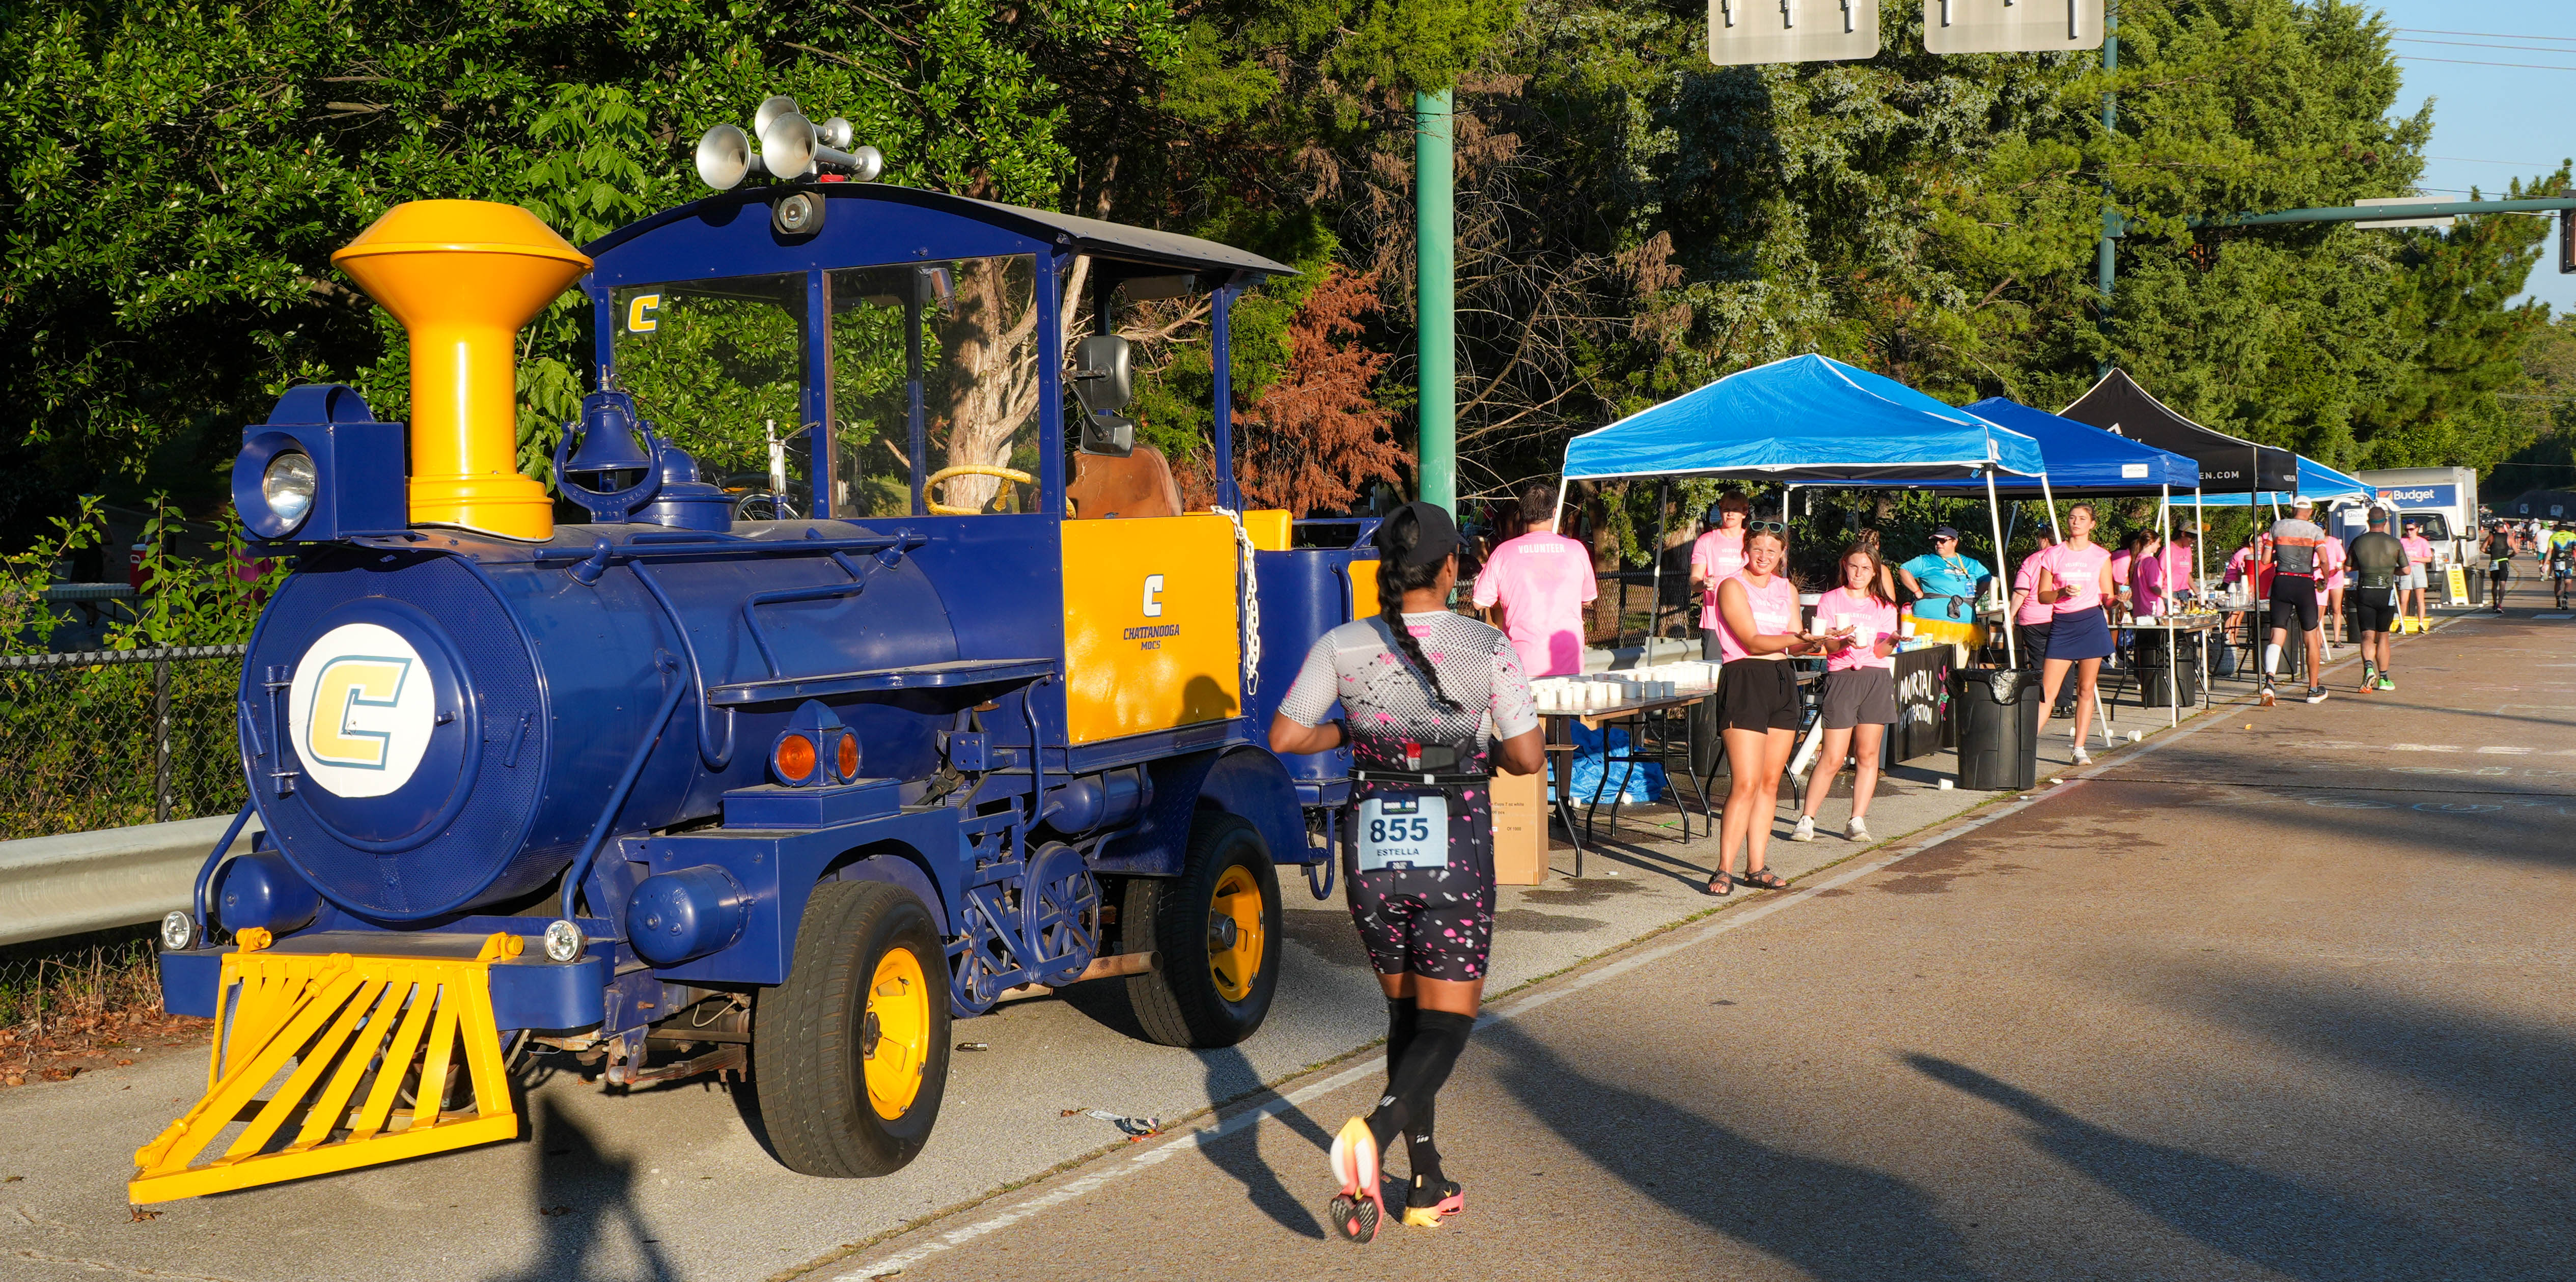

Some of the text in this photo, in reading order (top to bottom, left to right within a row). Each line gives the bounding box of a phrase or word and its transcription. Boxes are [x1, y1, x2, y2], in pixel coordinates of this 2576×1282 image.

[628, 293, 661, 333] C
[2199, 471, 2239, 479] EN.COM
[2394, 489, 2435, 502] Budget
[1518, 543, 1565, 554] VOLUNTEER
[1143, 574, 1164, 618] C
[1123, 624, 1180, 640] CHATTANOOGA
[1141, 640, 1161, 650] MOCS
[1900, 670, 1934, 704] MORTAL
[306, 655, 413, 771] C
[1899, 703, 1932, 733] HYDRATION
[1370, 818, 1428, 843] 855
[1377, 848, 1420, 857] ESTELLA
